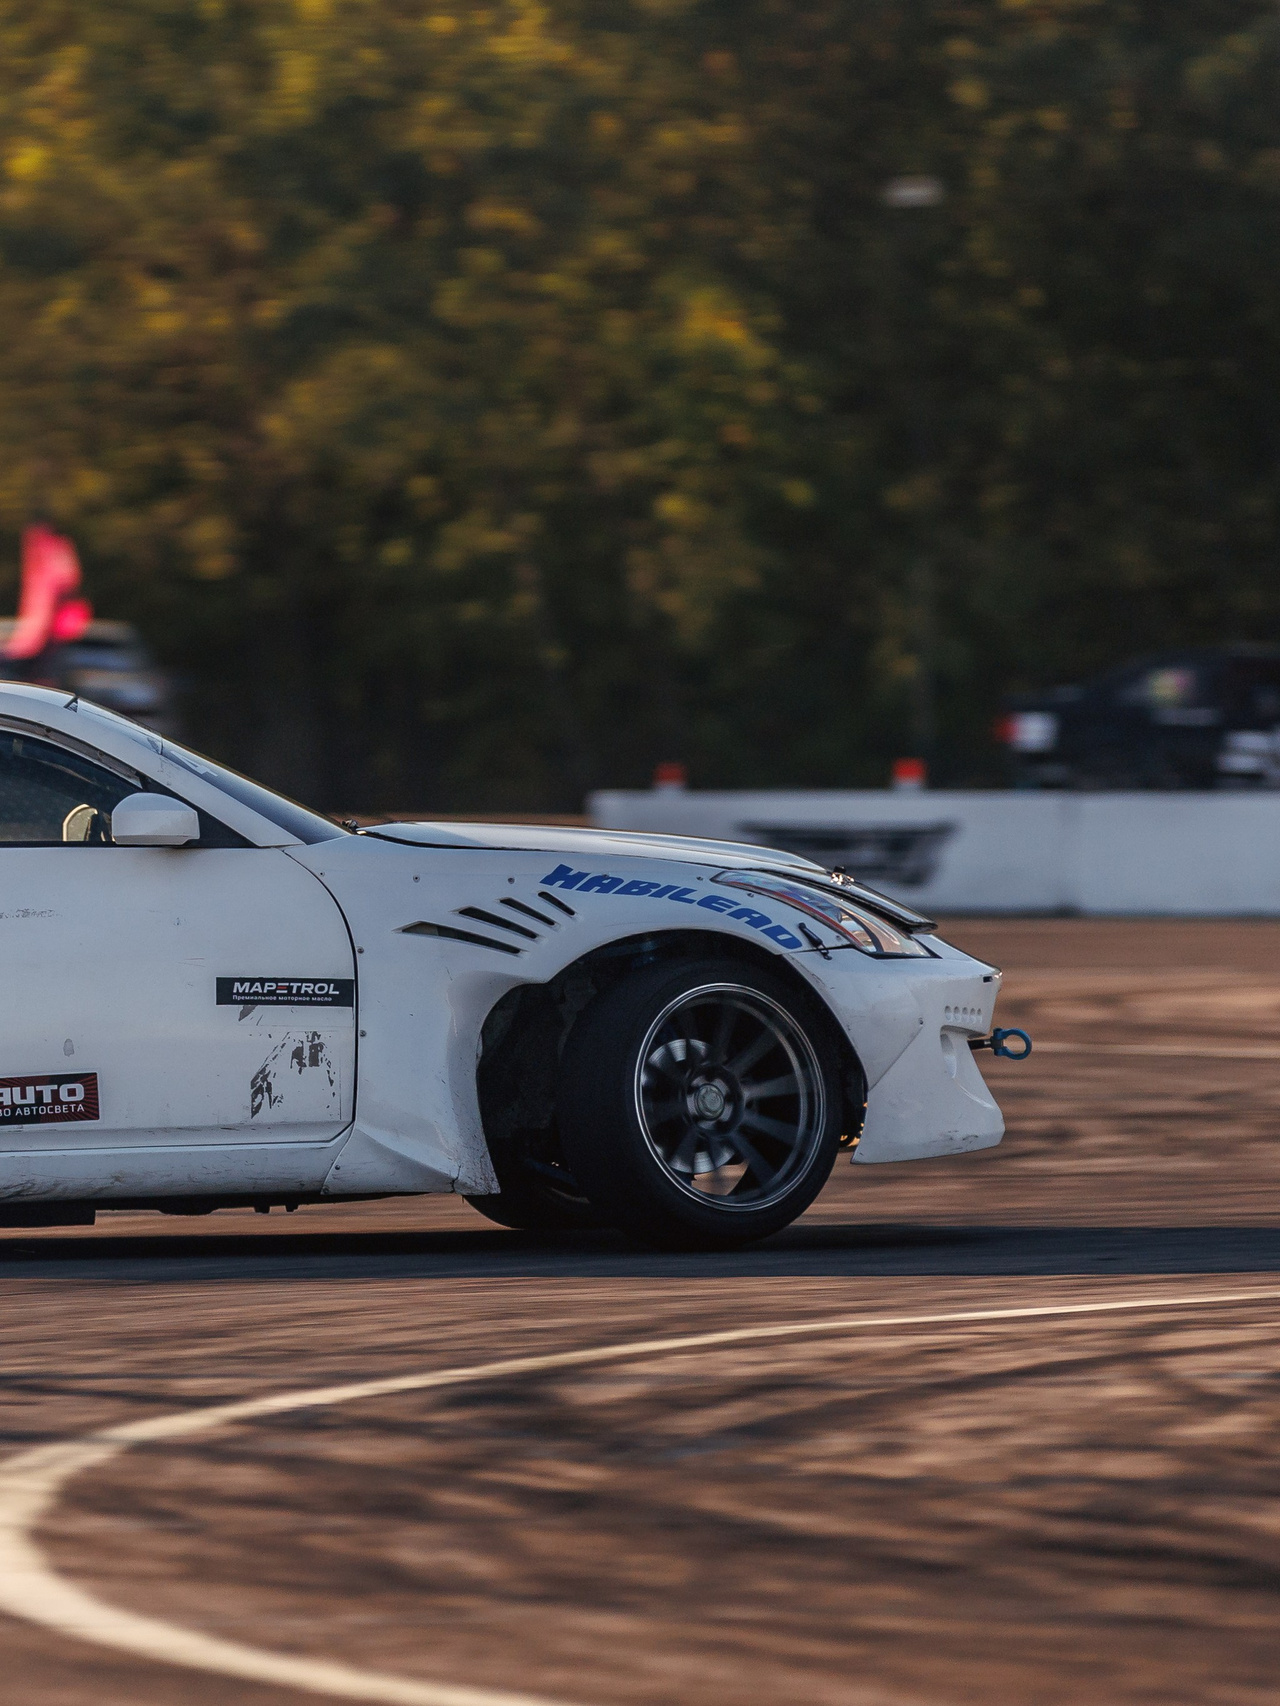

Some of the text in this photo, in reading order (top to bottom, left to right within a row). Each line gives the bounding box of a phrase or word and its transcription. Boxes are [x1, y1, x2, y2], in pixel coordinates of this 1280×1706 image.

[539, 863, 803, 950] HABILEAD
[232, 981, 340, 995] MAPETROL
[15, 1103, 85, 1117] АВТОСВЕТА
